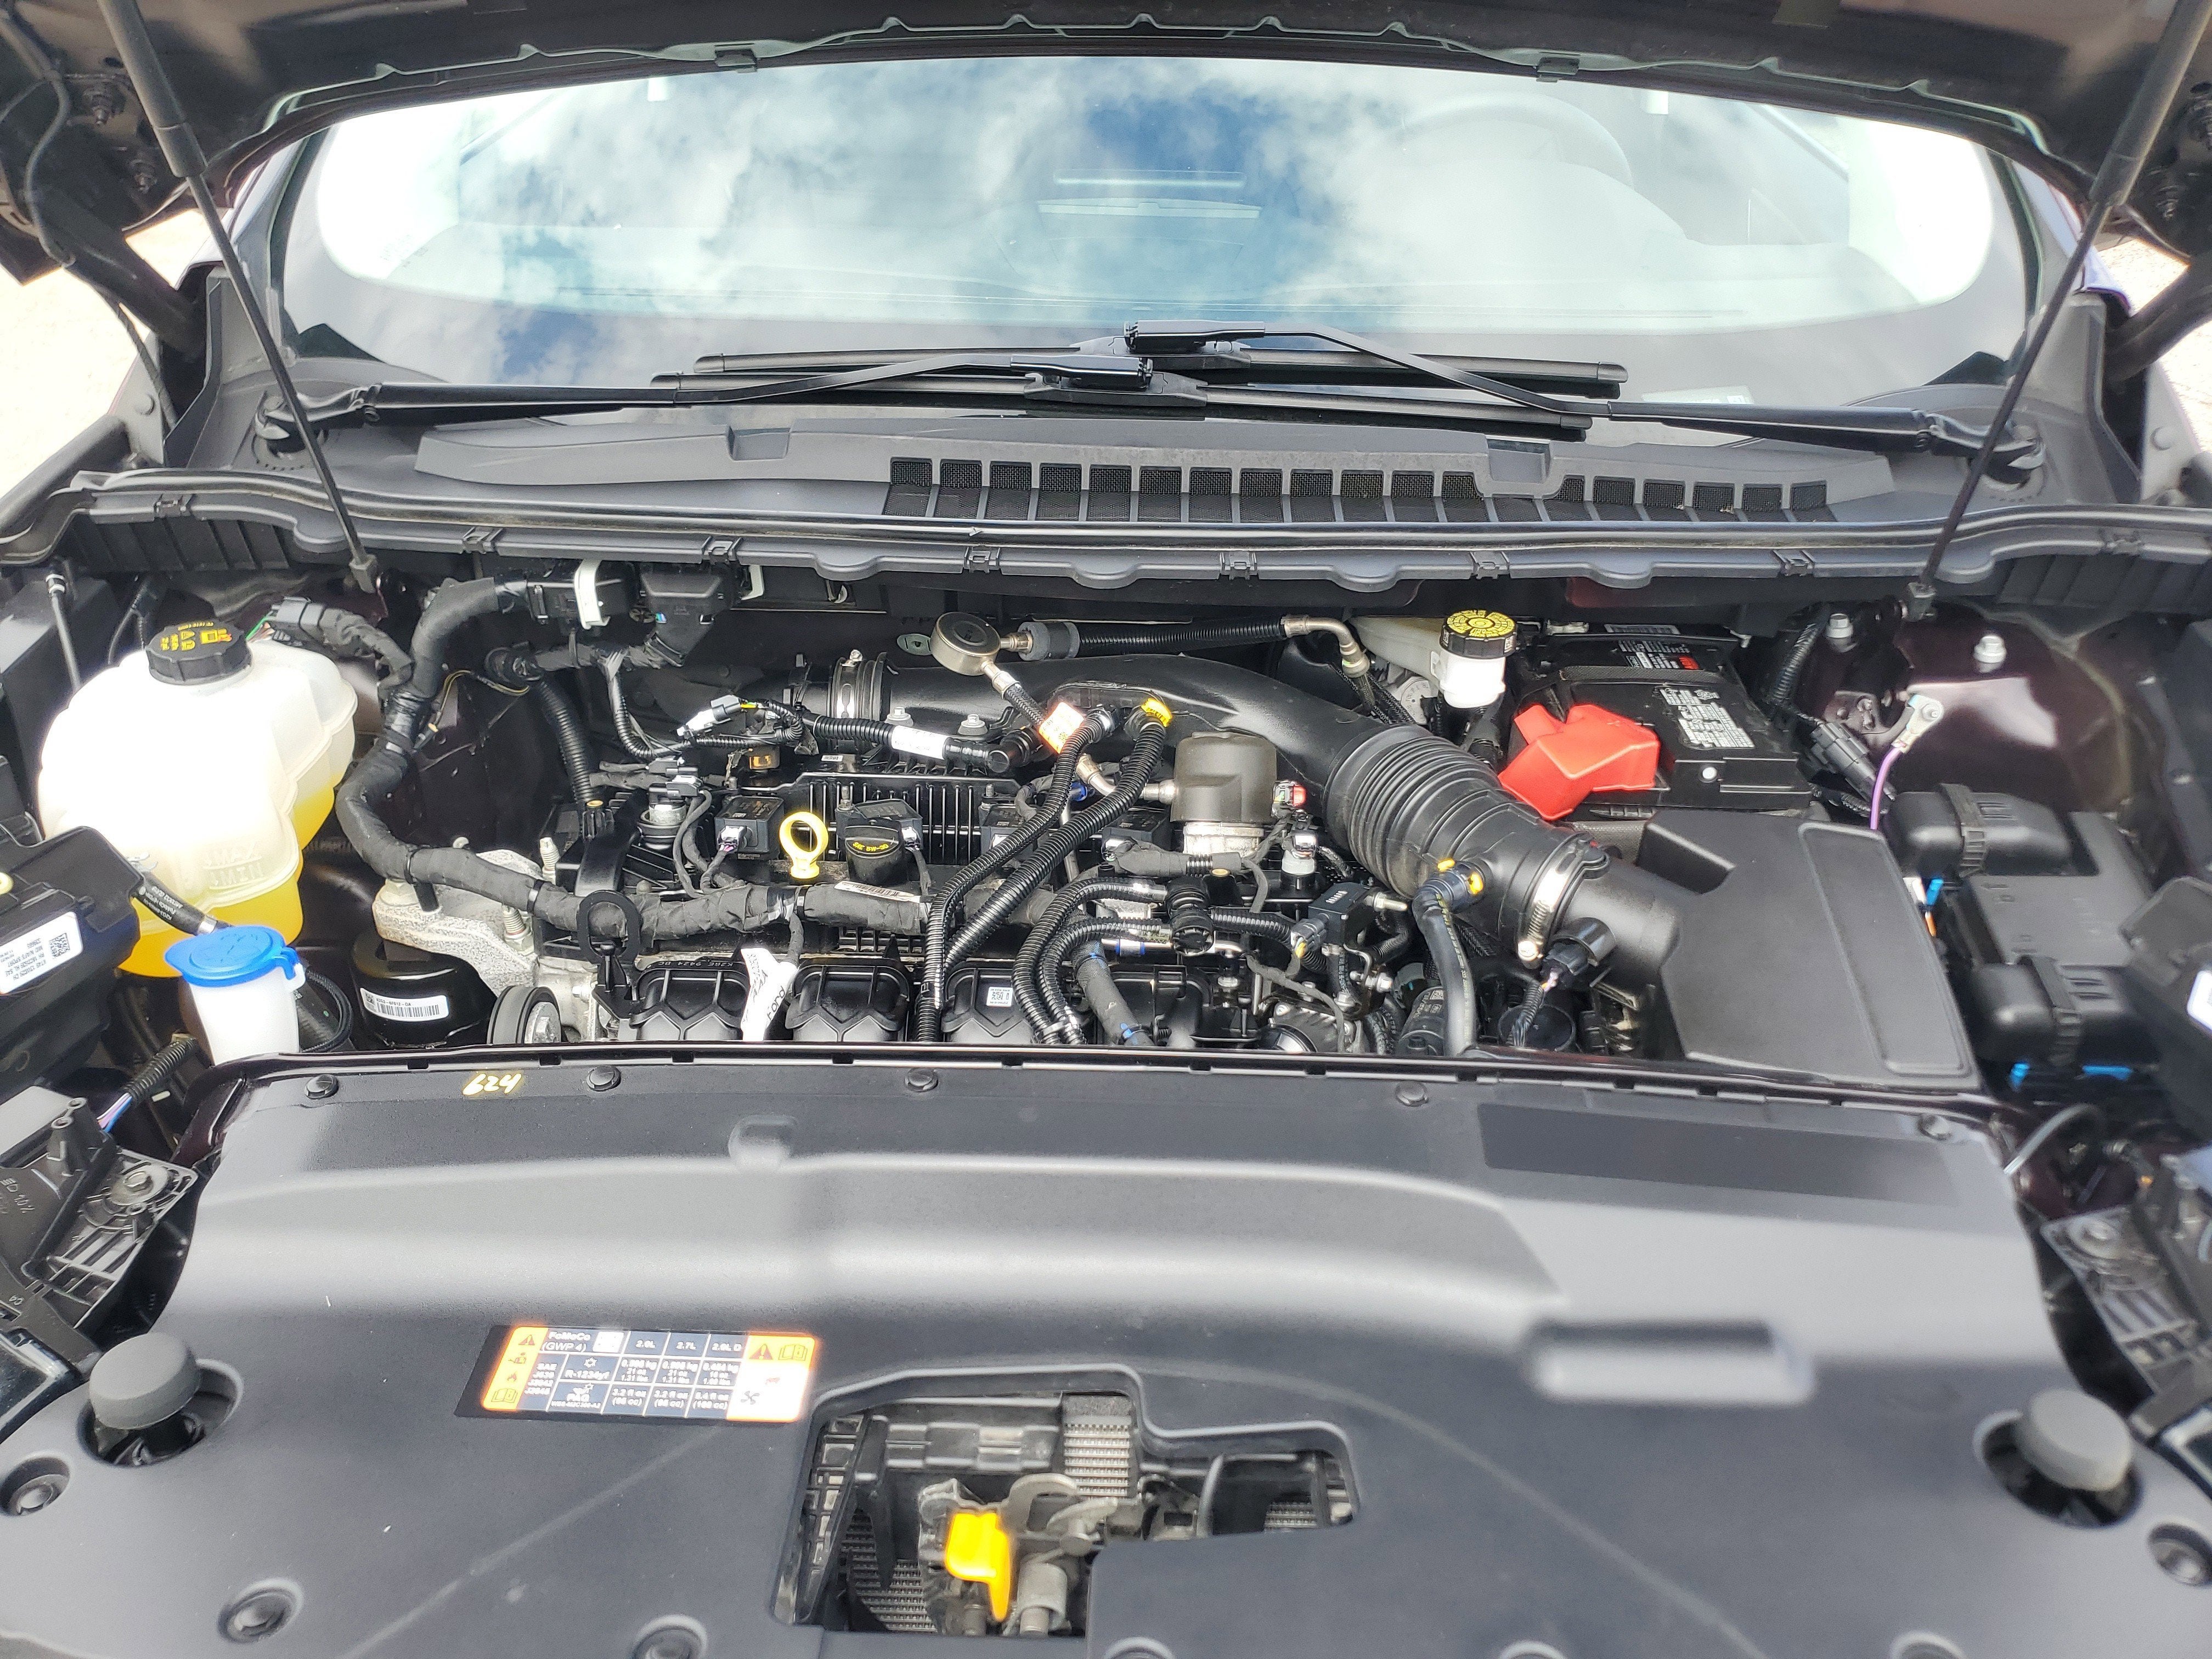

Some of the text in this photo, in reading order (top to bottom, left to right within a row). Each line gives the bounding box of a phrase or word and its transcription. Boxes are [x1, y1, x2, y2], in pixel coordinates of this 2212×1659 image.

[853, 842, 865, 850] SAE
[8, 956, 21, 967] SPORT
[549, 1331, 591, 1341] FoMoCo
[541, 1342, 587, 1352] (GWP 4)
[676, 1341, 696, 1350] 2.7L
[612, 1388, 627, 1397] 3.2
[654, 1390, 668, 1398] 3.2
